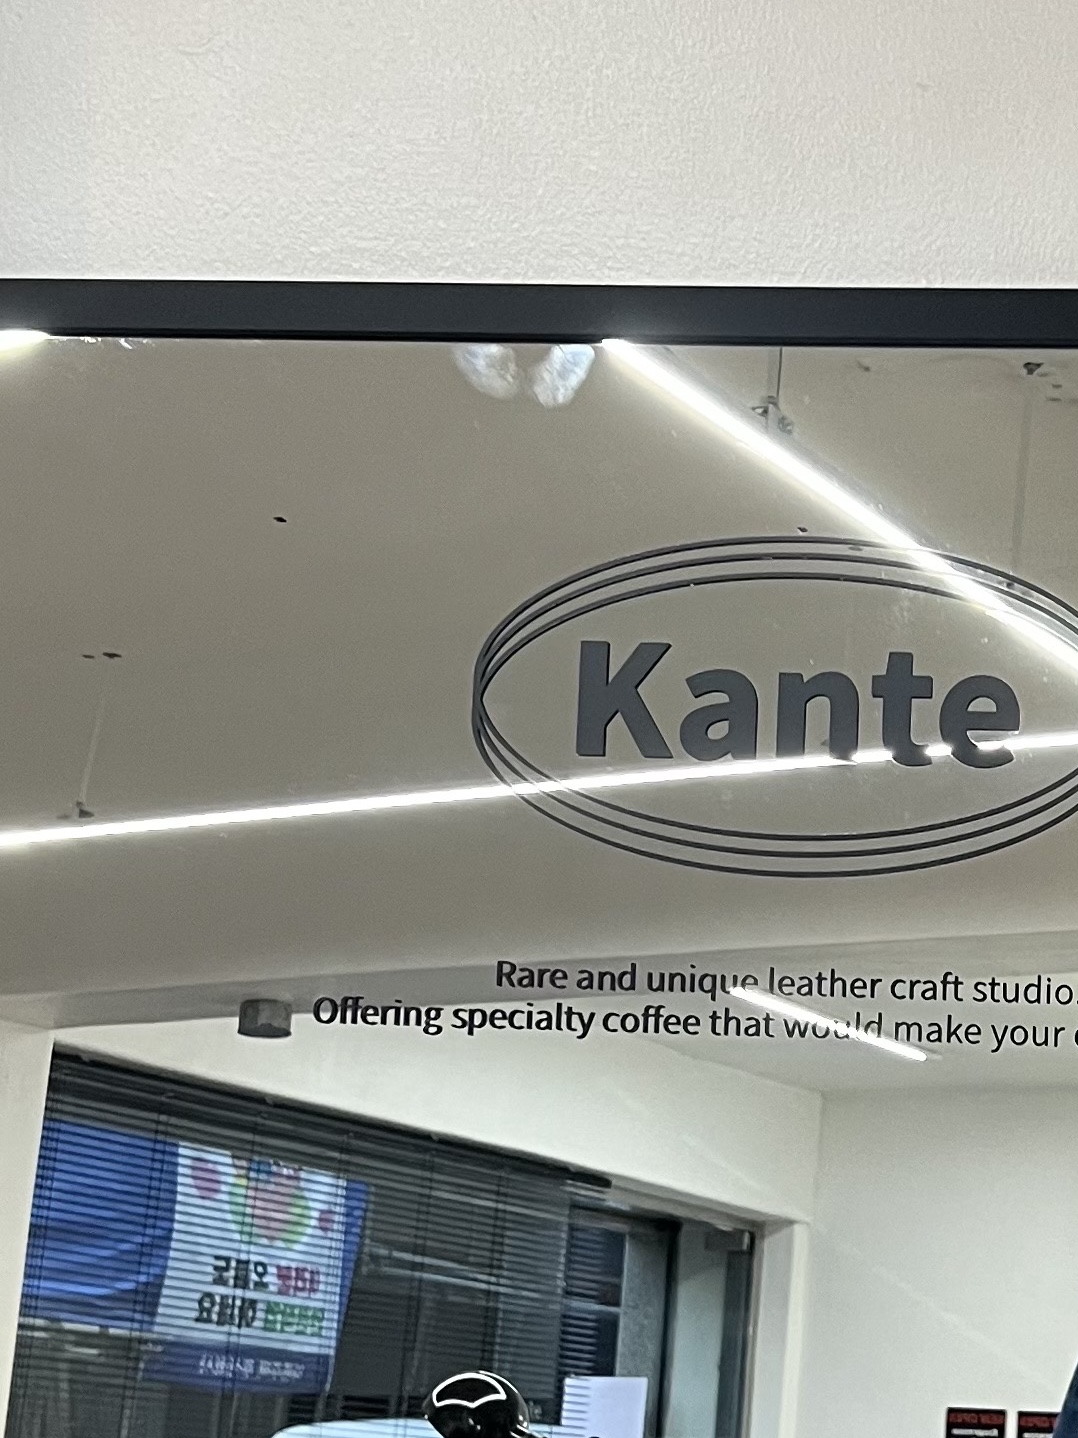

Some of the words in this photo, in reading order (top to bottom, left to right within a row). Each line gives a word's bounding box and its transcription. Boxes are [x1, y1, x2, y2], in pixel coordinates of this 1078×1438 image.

[574, 639, 1021, 769] Kante
[496, 960, 568, 991] Rare
[576, 963, 637, 992] and
[647, 963, 759, 1002] unique
[769, 967, 883, 999] leather
[889, 971, 964, 1003] craft
[312, 996, 444, 1036] Offering
[451, 1001, 597, 1040] specialty
[602, 1005, 701, 1036] coffee
[709, 1007, 776, 1038] that
[783, 1012, 883, 1041] would
[894, 1014, 982, 1045] make
[991, 1020, 1066, 1053] your
